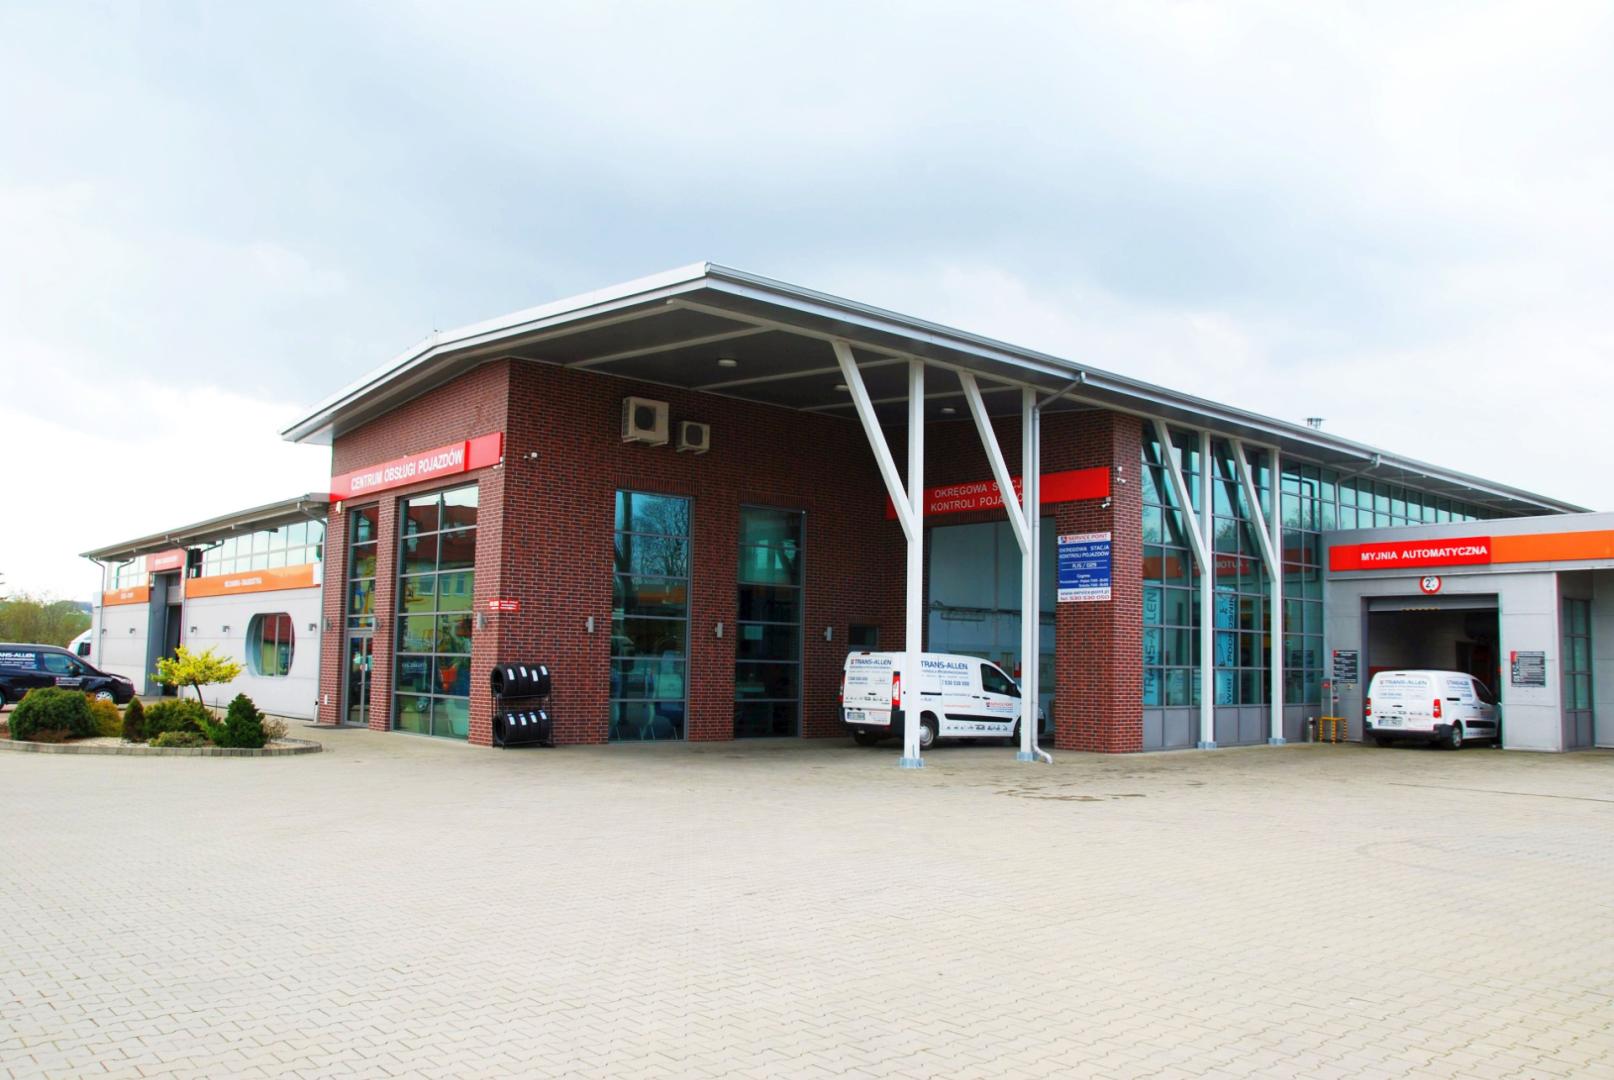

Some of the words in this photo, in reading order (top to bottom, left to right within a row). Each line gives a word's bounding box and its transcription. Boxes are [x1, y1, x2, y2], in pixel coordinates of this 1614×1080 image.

[351, 470, 383, 491] CENTRUM
[384, 462, 416, 482] OBSŁUGI
[418, 448, 464, 474] POJAZDÓW
[934, 484, 988, 499] OKRĘGOWA
[931, 499, 976, 512] KONTROLI
[1361, 551, 1398, 561] MYJNIA
[1402, 545, 1488, 559] AUTOMATYCZNA
[920, 660, 969, 670] TRANS-ALLEN
